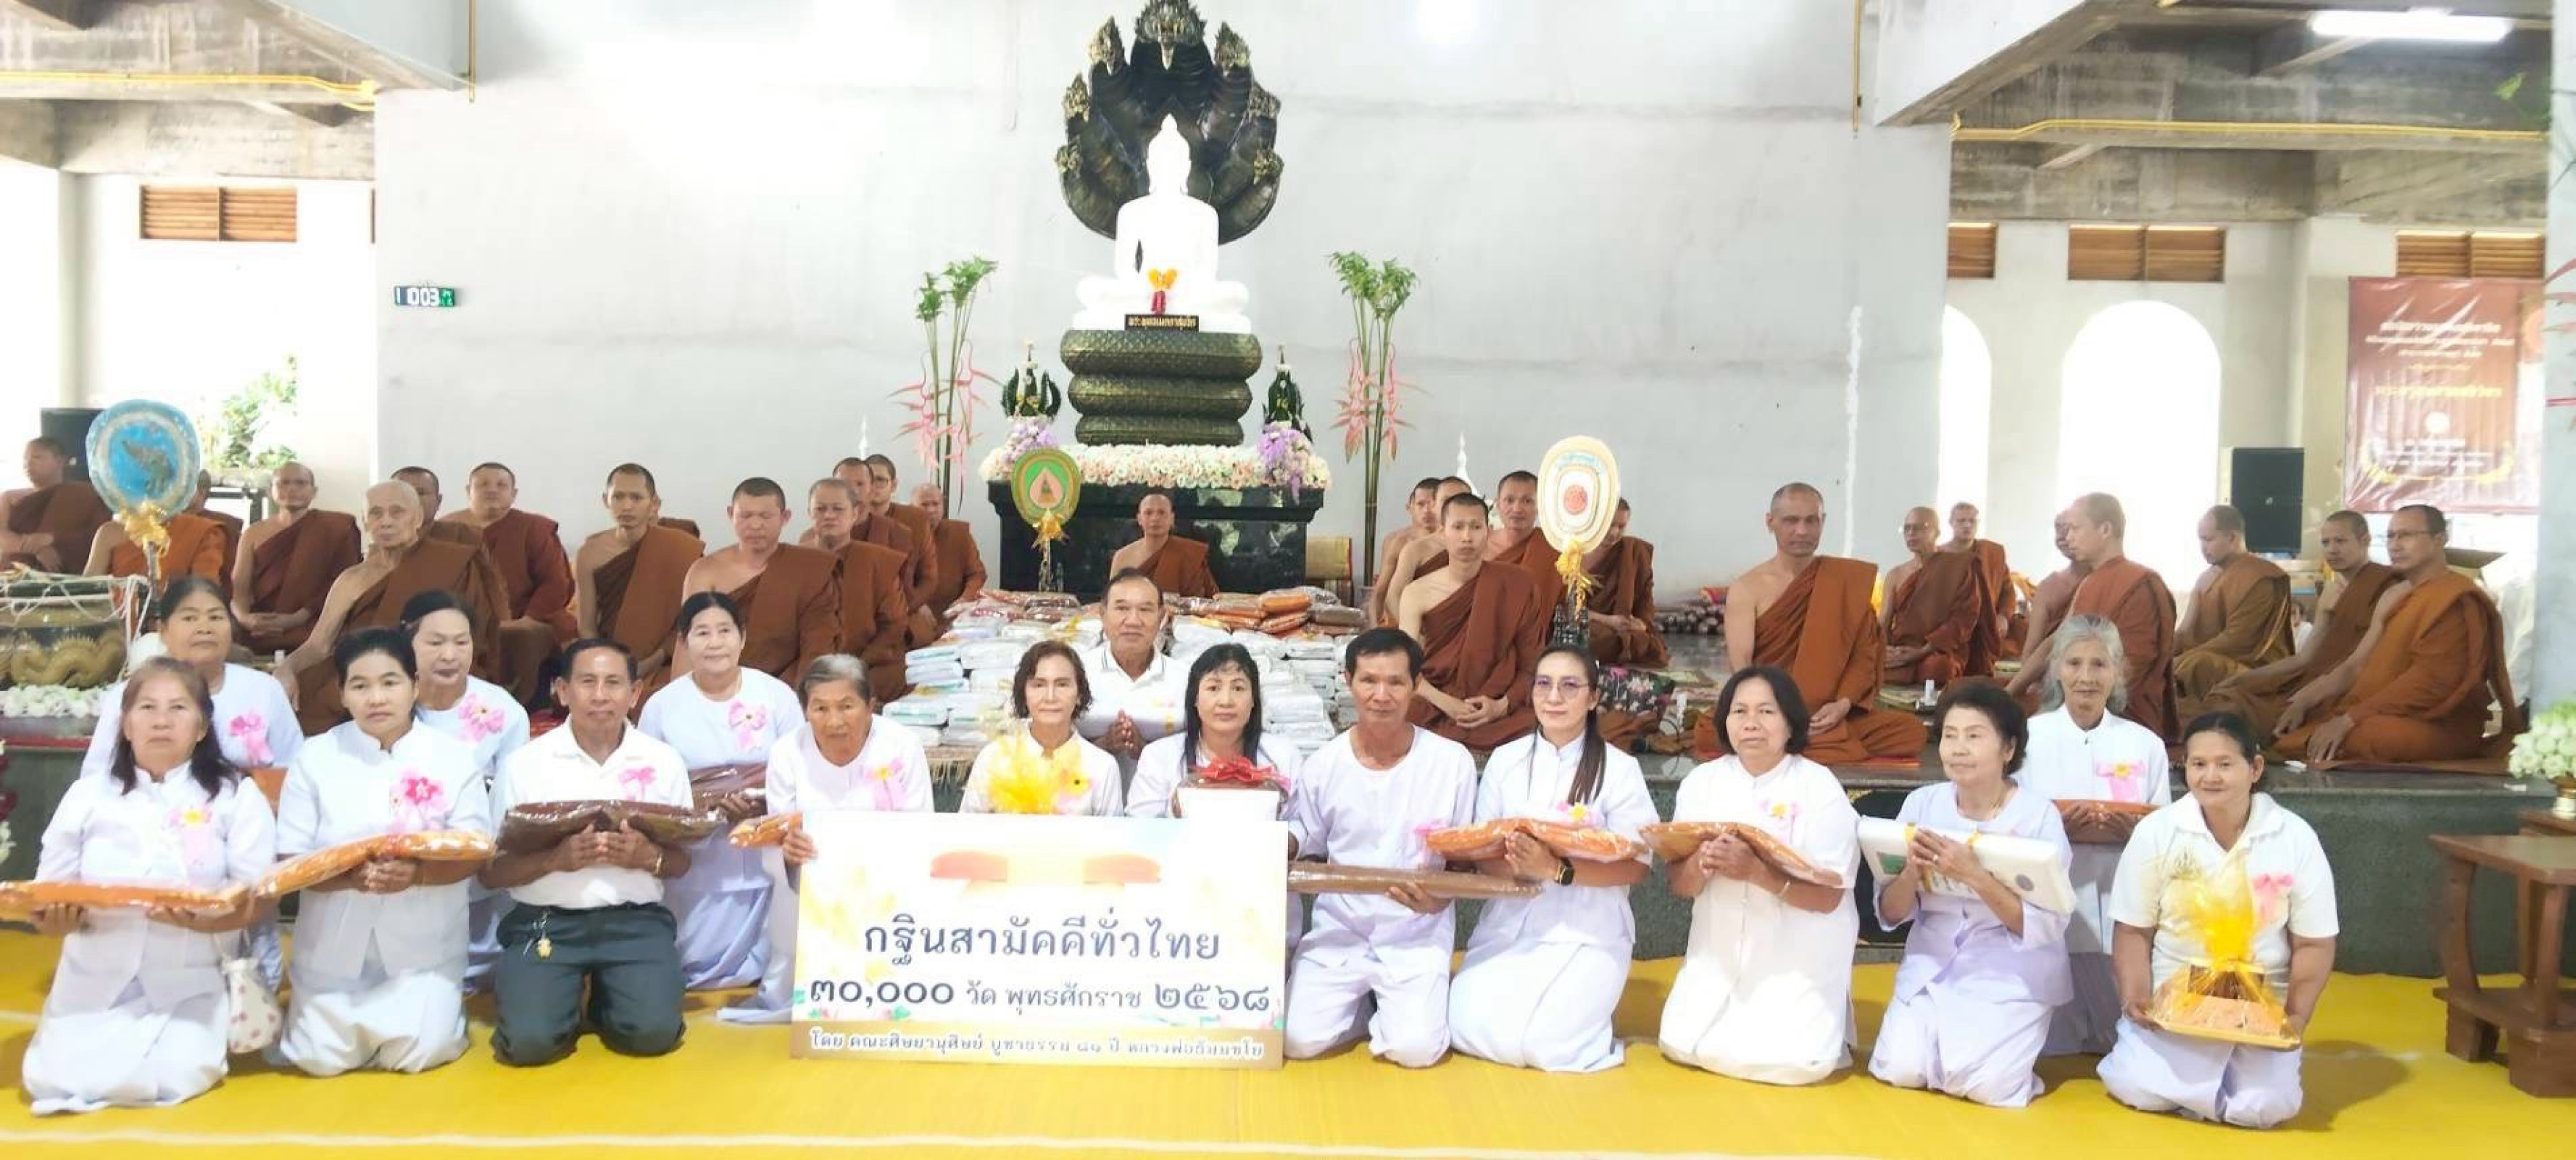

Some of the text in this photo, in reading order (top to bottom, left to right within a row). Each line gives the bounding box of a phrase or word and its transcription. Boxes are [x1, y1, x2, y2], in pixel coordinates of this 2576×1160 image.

[864, 906, 1220, 966] กฐินสามัคคีทั่วไทย
[810, 979, 1270, 1016] ๓๐,๐๐๐ วัด พุทธศักราช ๒๕๖๘
[810, 1030, 844, 1048] โดย
